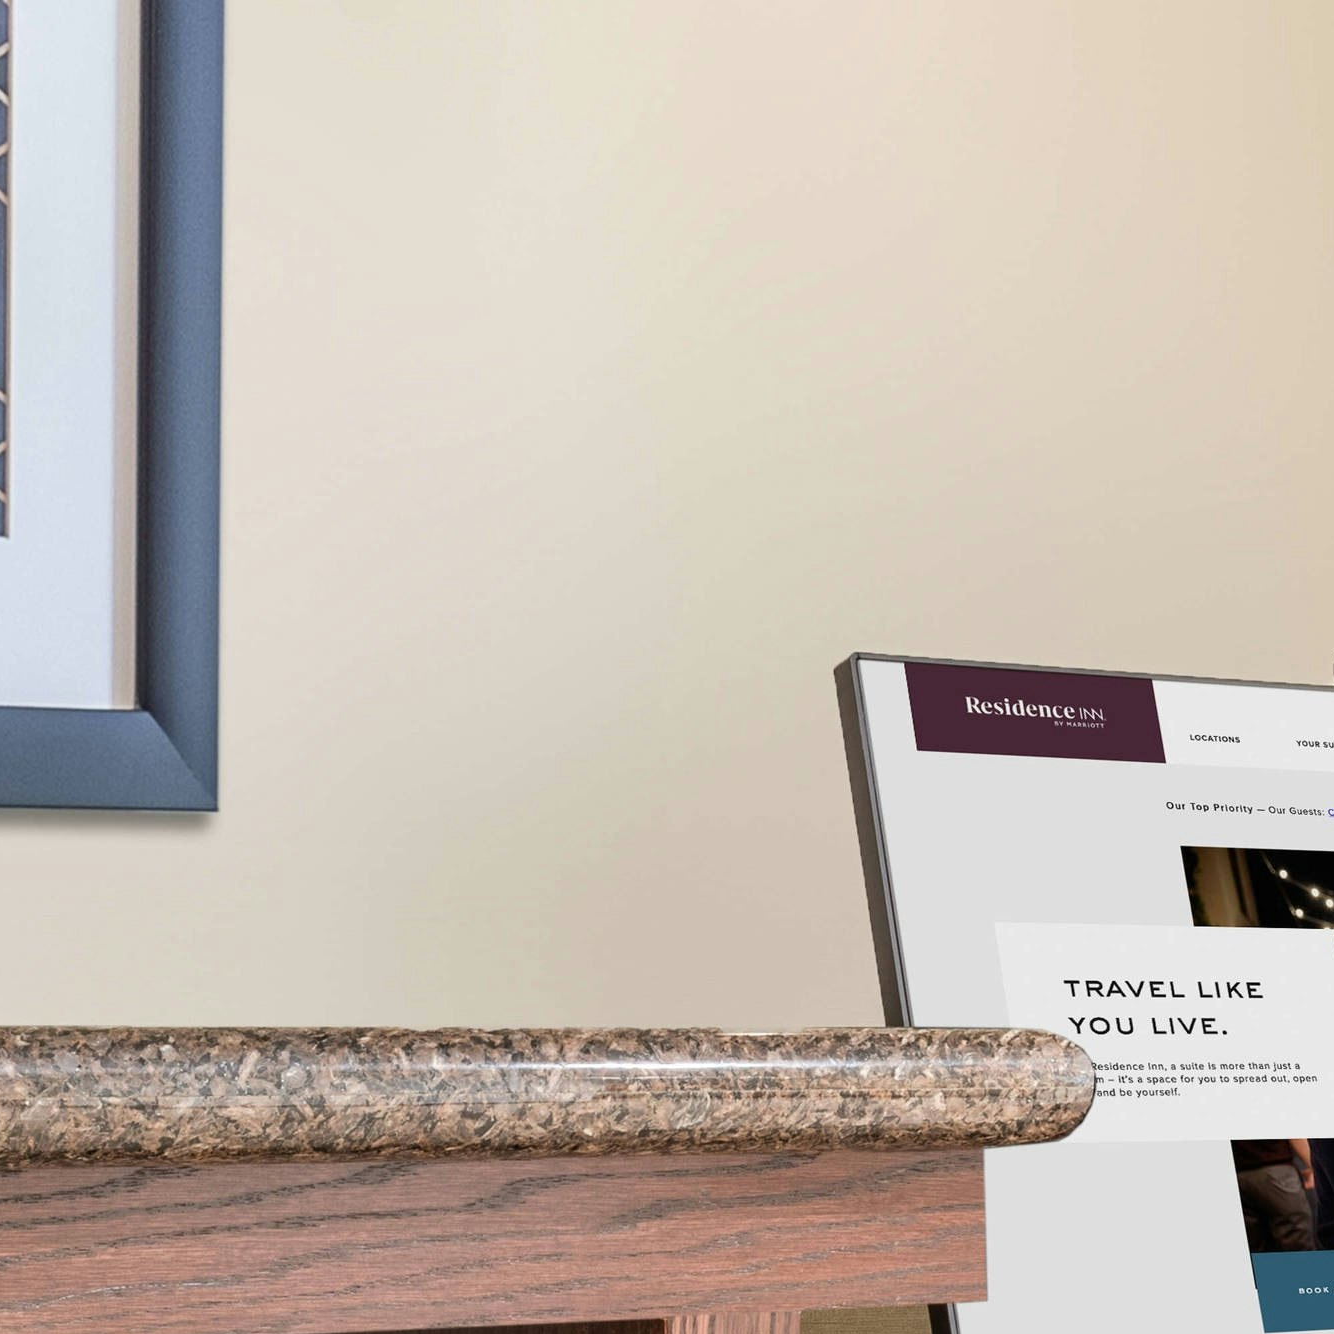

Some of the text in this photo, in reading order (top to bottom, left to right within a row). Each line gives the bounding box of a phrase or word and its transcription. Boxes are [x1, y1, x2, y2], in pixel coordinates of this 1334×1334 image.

[965, 696, 1105, 721] Residence INN
[1067, 721, 1105, 729] MARRIOTT
[1189, 733, 1241, 744] LOCATIONS
[1296, 740, 1320, 748] YOUR
[1166, 801, 1185, 810] Our
[1190, 802, 1210, 812] Top
[1213, 803, 1254, 815] Priority
[1268, 805, 1286, 815] Our
[1289, 806, 1325, 817] Guests:
[1064, 980, 1264, 999] TRAVEL LIKE
[1068, 1016, 1228, 1035] YOU LIVE.
[1092, 1062, 1145, 1071] Residence
[1148, 1062, 1168, 1072] Inn,
[1179, 1062, 1205, 1071] suite
[1207, 1061, 1217, 1070] is
[1219, 1062, 1245, 1070] more
[1248, 1061, 1271, 1070] than
[1273, 1062, 1292, 1072] just
[1146, 1076, 1177, 1086] space
[1180, 1074, 1195, 1083] for
[1197, 1075, 1217, 1085] you
[1219, 1074, 1230, 1083] to
[1232, 1074, 1268, 1085] spread
[1292, 1075, 1318, 1085] open
[1096, 1087, 1181, 1098] and be yourself.
[1298, 1285, 1330, 1295] BOOK
